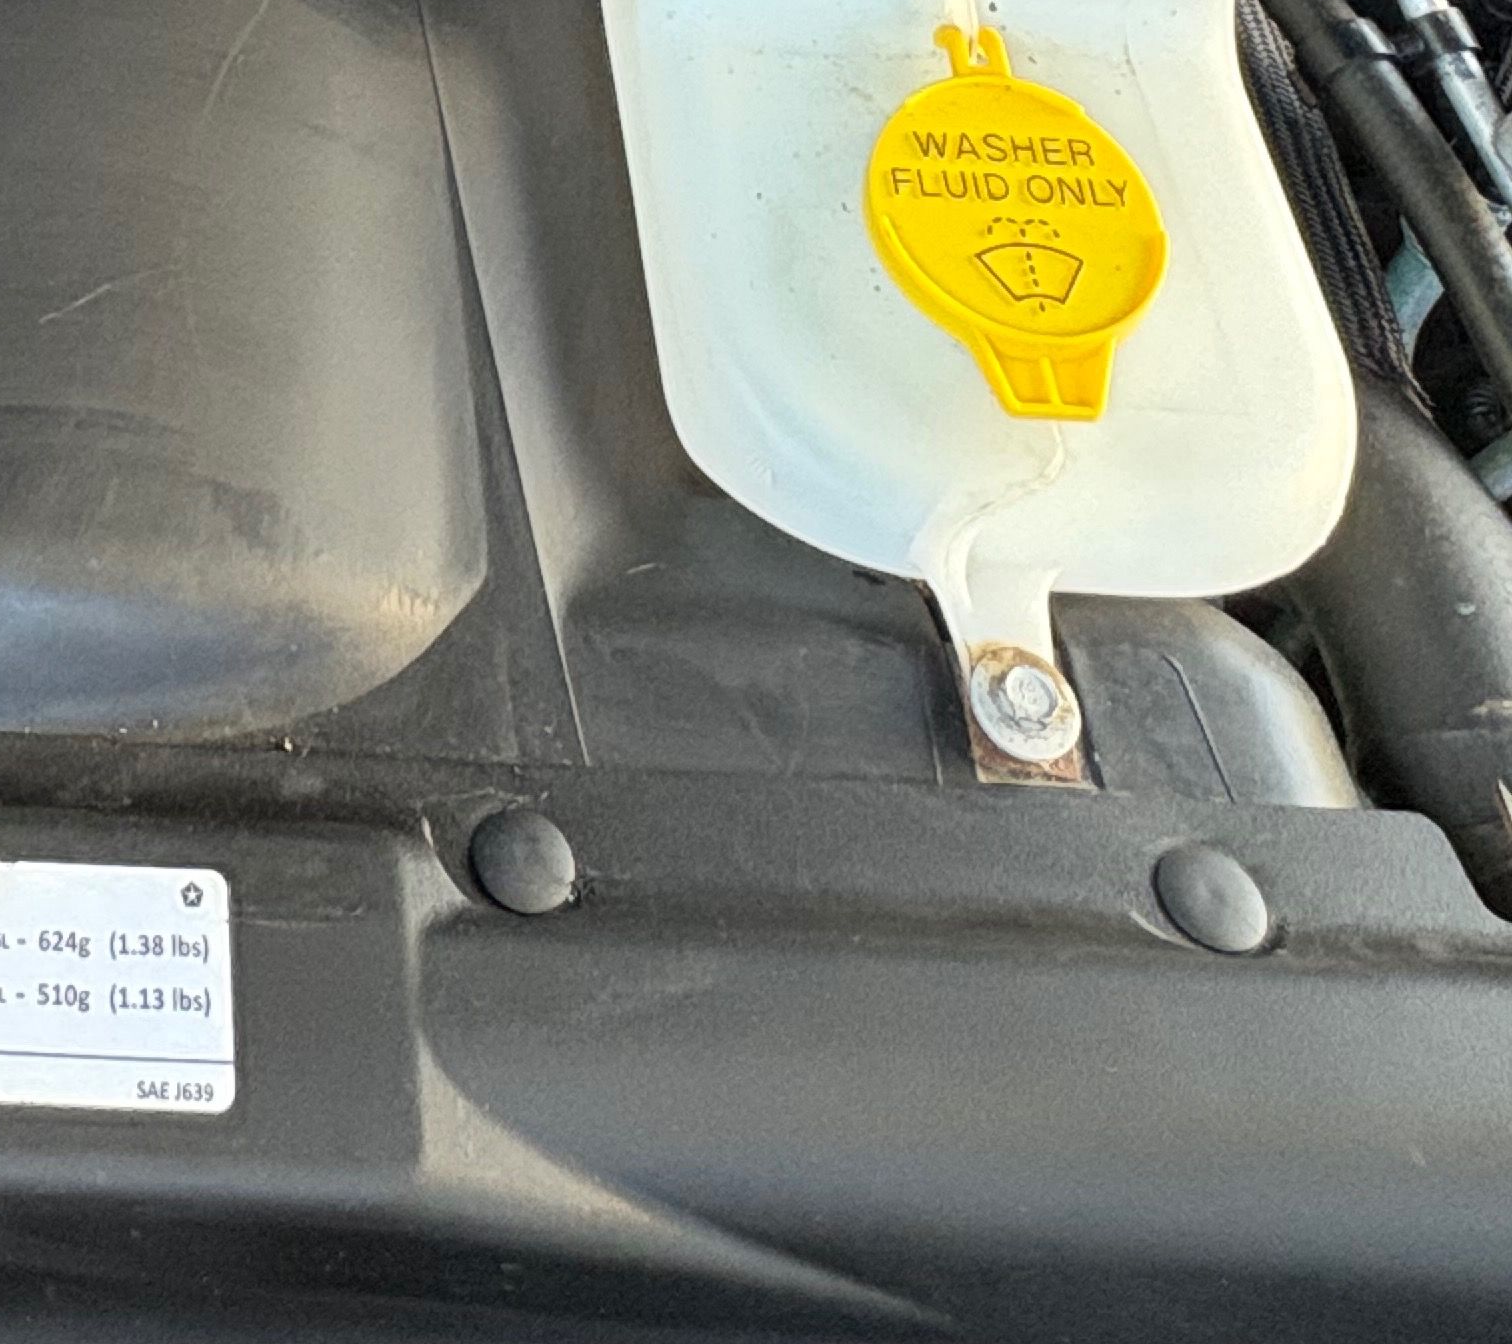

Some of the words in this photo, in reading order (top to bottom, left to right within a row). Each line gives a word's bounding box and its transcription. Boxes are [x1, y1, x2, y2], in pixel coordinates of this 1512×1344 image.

[912, 130, 1097, 168] WASHER
[890, 167, 1010, 202] FLUID
[1025, 175, 1129, 209] ONLY
[38, 930, 92, 959] 624g
[109, 930, 165, 961] (1.38
[170, 934, 209, 964] lbs)
[36, 983, 91, 1014] 510g
[109, 983, 165, 1015] (1.13
[172, 986, 212, 1018] lbs)
[136, 1080, 170, 1100] SAE
[174, 1081, 215, 1103] J639
